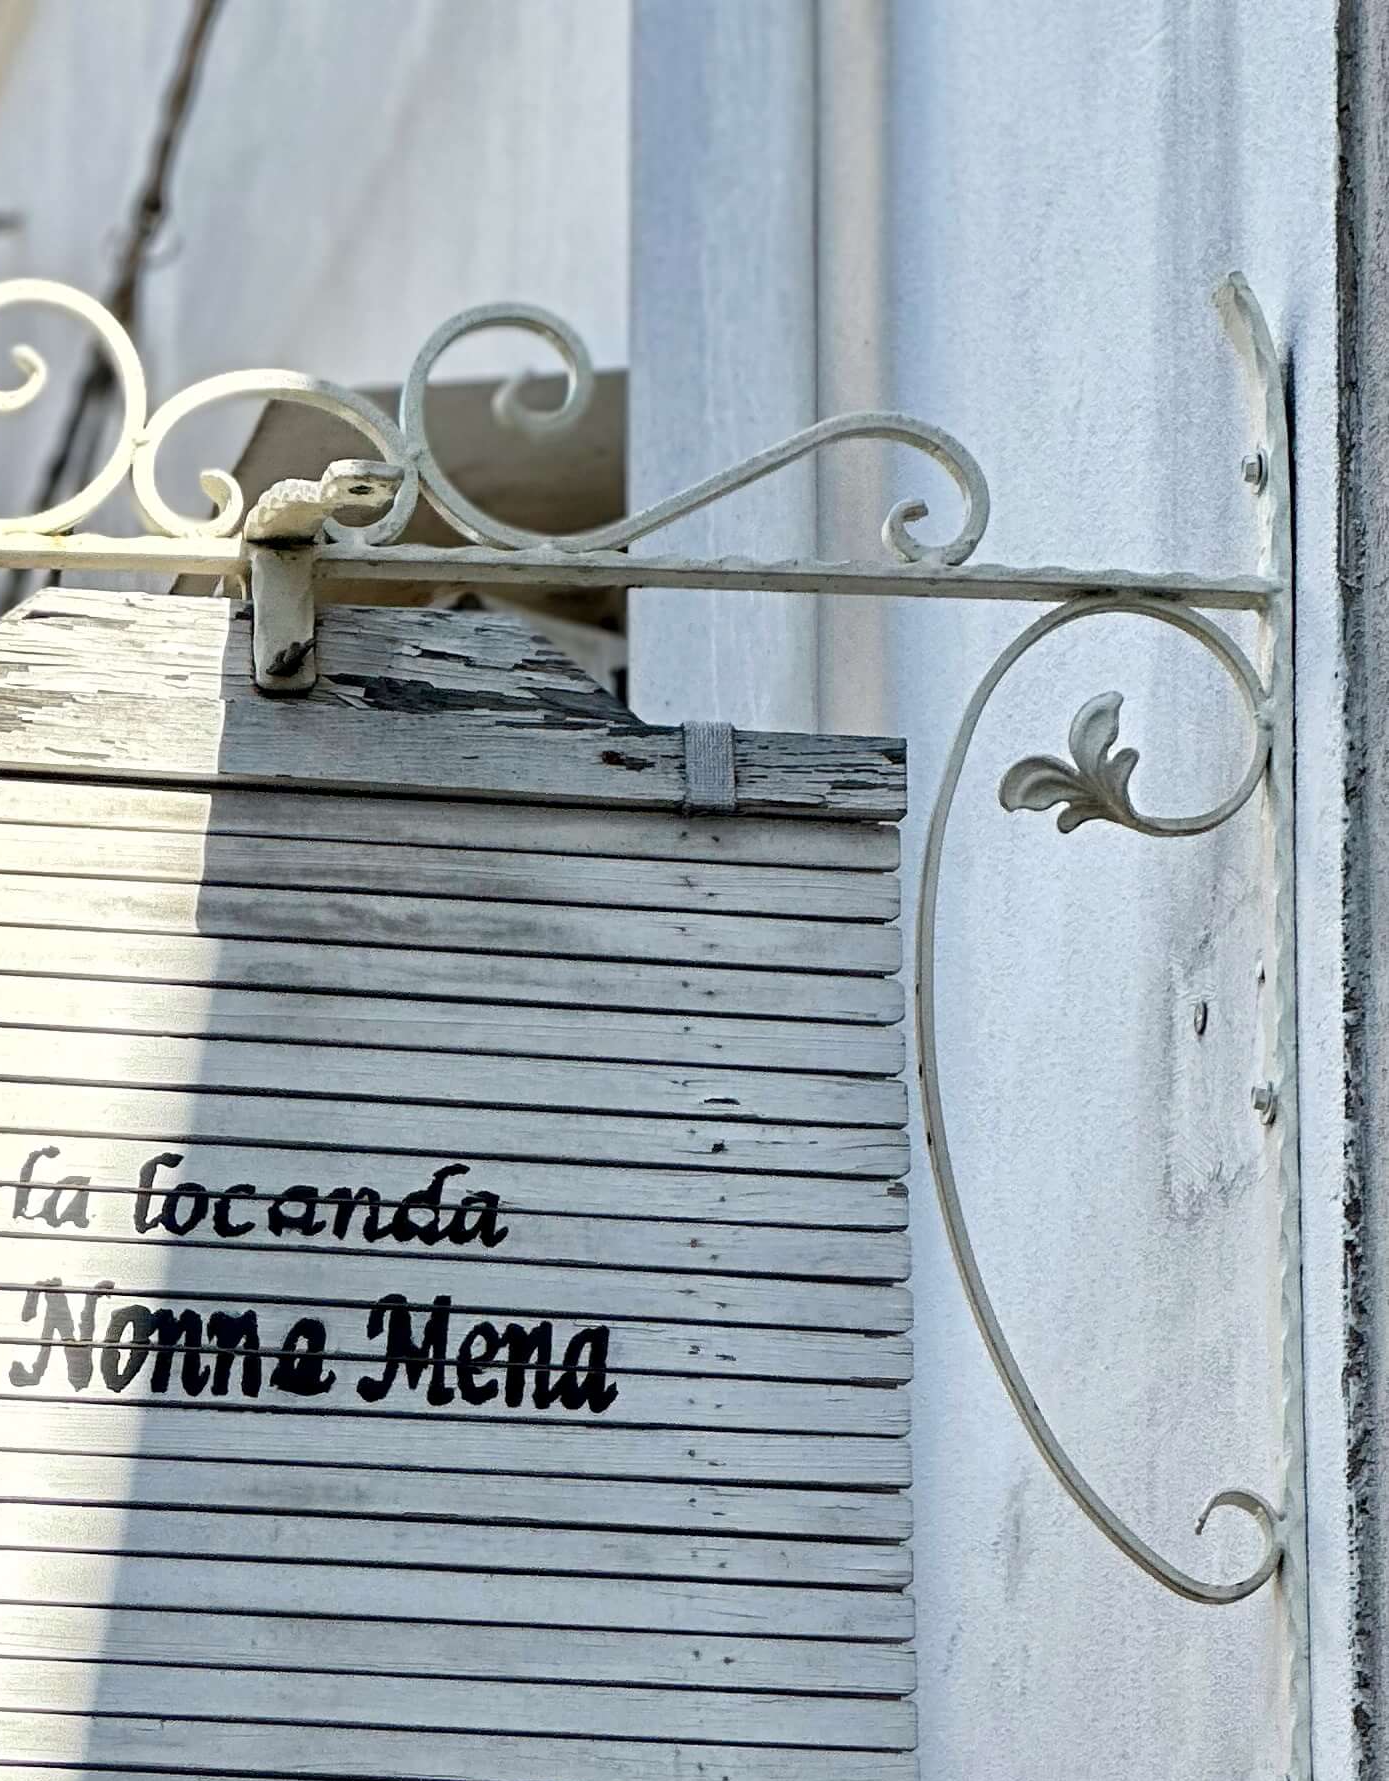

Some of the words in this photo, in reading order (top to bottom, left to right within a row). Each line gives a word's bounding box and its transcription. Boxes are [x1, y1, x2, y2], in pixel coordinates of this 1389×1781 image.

[13, 1145, 93, 1229] la
[134, 1152, 509, 1248] locanda
[11, 1278, 337, 1398] Nonna
[356, 1294, 619, 1414] Mena
